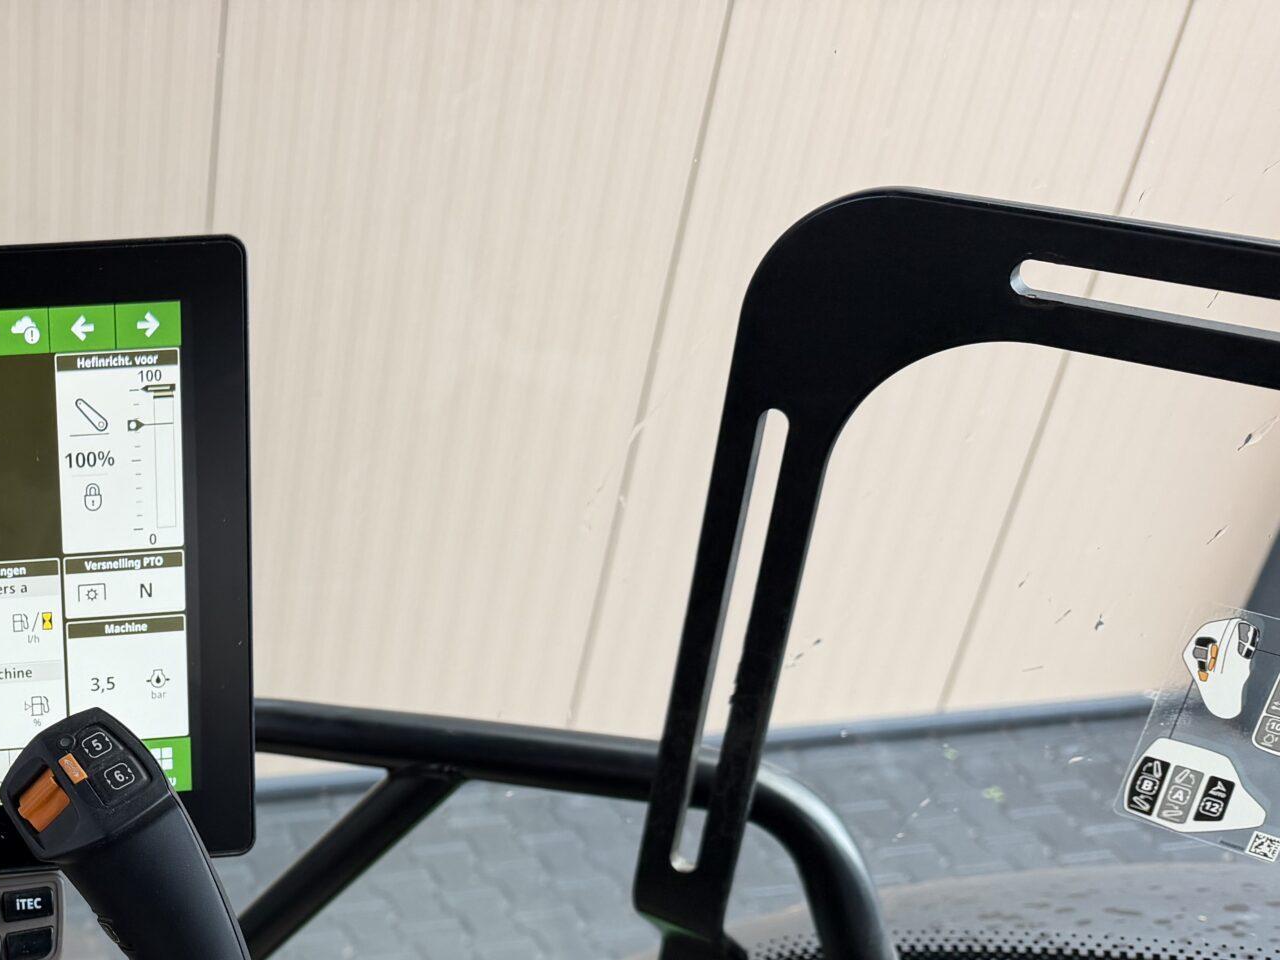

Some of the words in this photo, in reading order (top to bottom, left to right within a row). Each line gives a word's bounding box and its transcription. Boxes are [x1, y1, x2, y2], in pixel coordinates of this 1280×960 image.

[76, 356, 133, 369] Hefinricht.
[134, 354, 159, 366] voor
[137, 369, 162, 382] 100
[64, 451, 115, 468] 100%
[149, 533, 157, 545] 0
[84, 557, 141, 572] Versnelling
[143, 556, 164, 567] PTO
[20, 584, 29, 594] a
[139, 582, 153, 598] N
[104, 622, 148, 635] Machine
[90, 676, 116, 695] 3,5
[151, 689, 167, 700] bar
[33, 718, 42, 728] %
[91, 739, 103, 752] 5
[1143, 780, 1153, 791] B
[1173, 789, 1184, 801] A
[1203, 801, 1219, 813] 12
